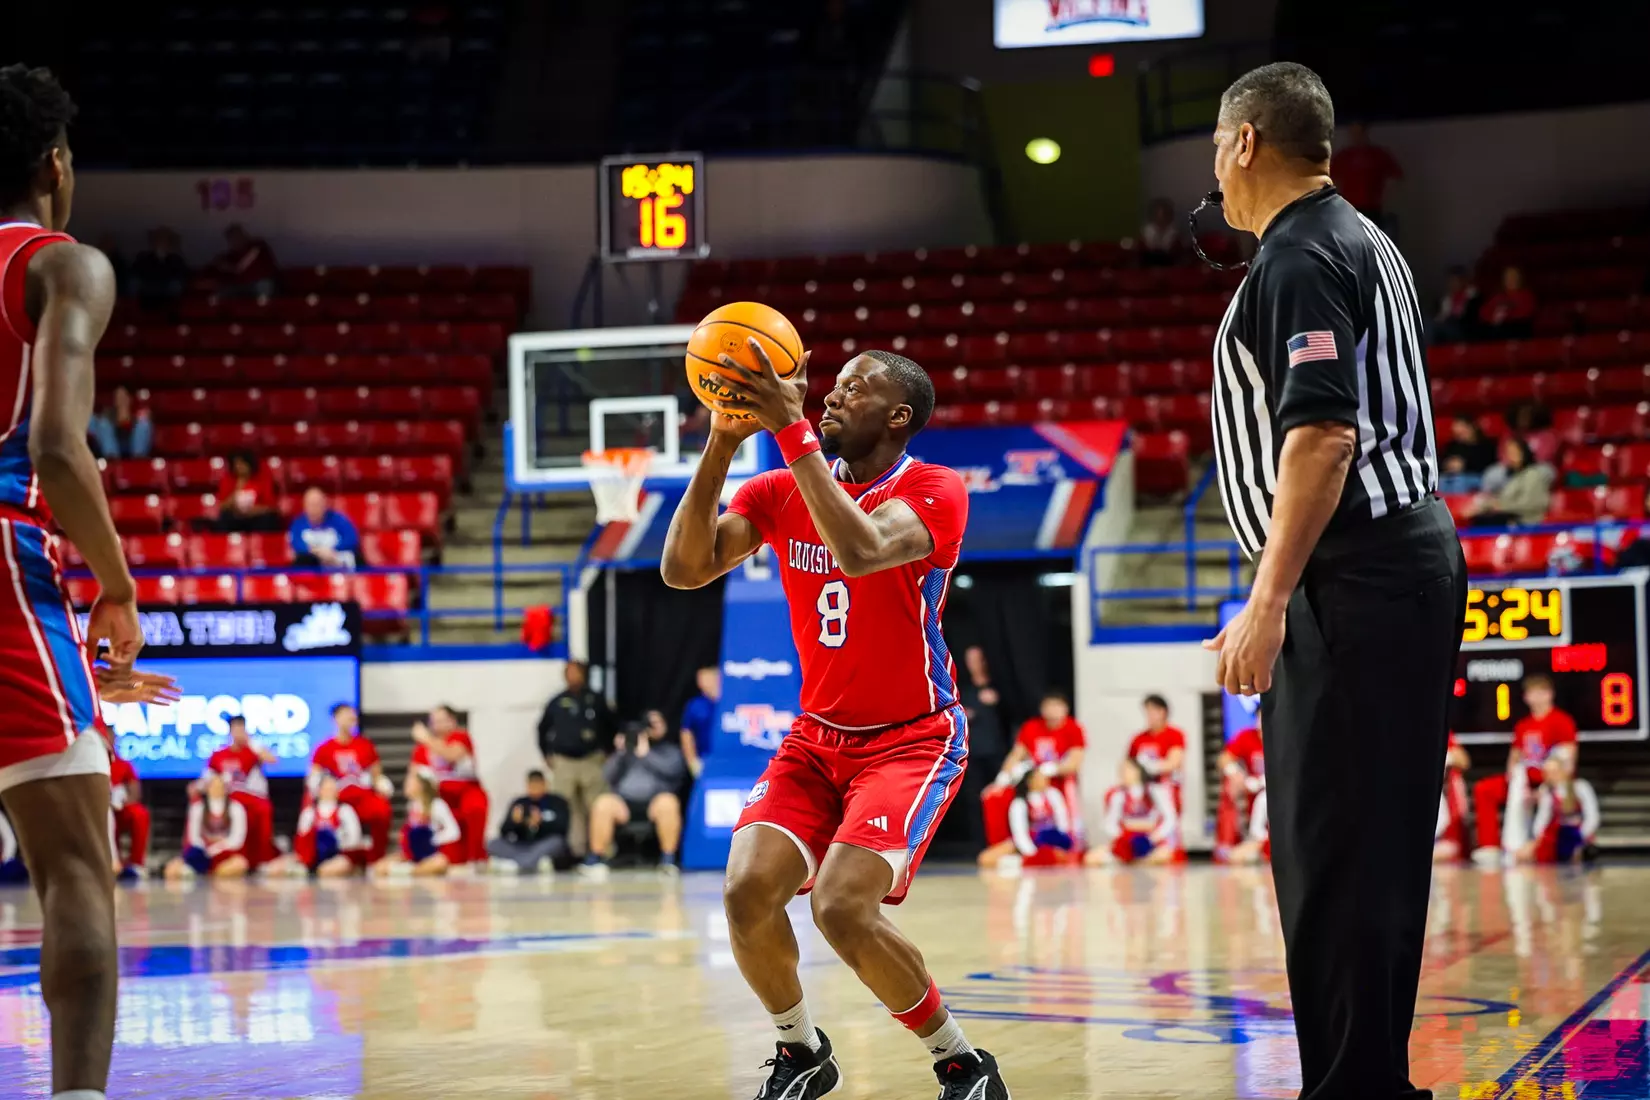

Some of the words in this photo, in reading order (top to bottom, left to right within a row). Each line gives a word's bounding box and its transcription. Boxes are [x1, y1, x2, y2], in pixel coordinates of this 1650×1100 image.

[640, 193, 687, 249] 16
[788, 538, 840, 575] LOUISI
[816, 579, 850, 648] 8
[1462, 588, 1562, 642] 5:24
[1497, 683, 1510, 721] 1
[1601, 673, 1633, 726] 8
[114, 735, 192, 761] DICAL
